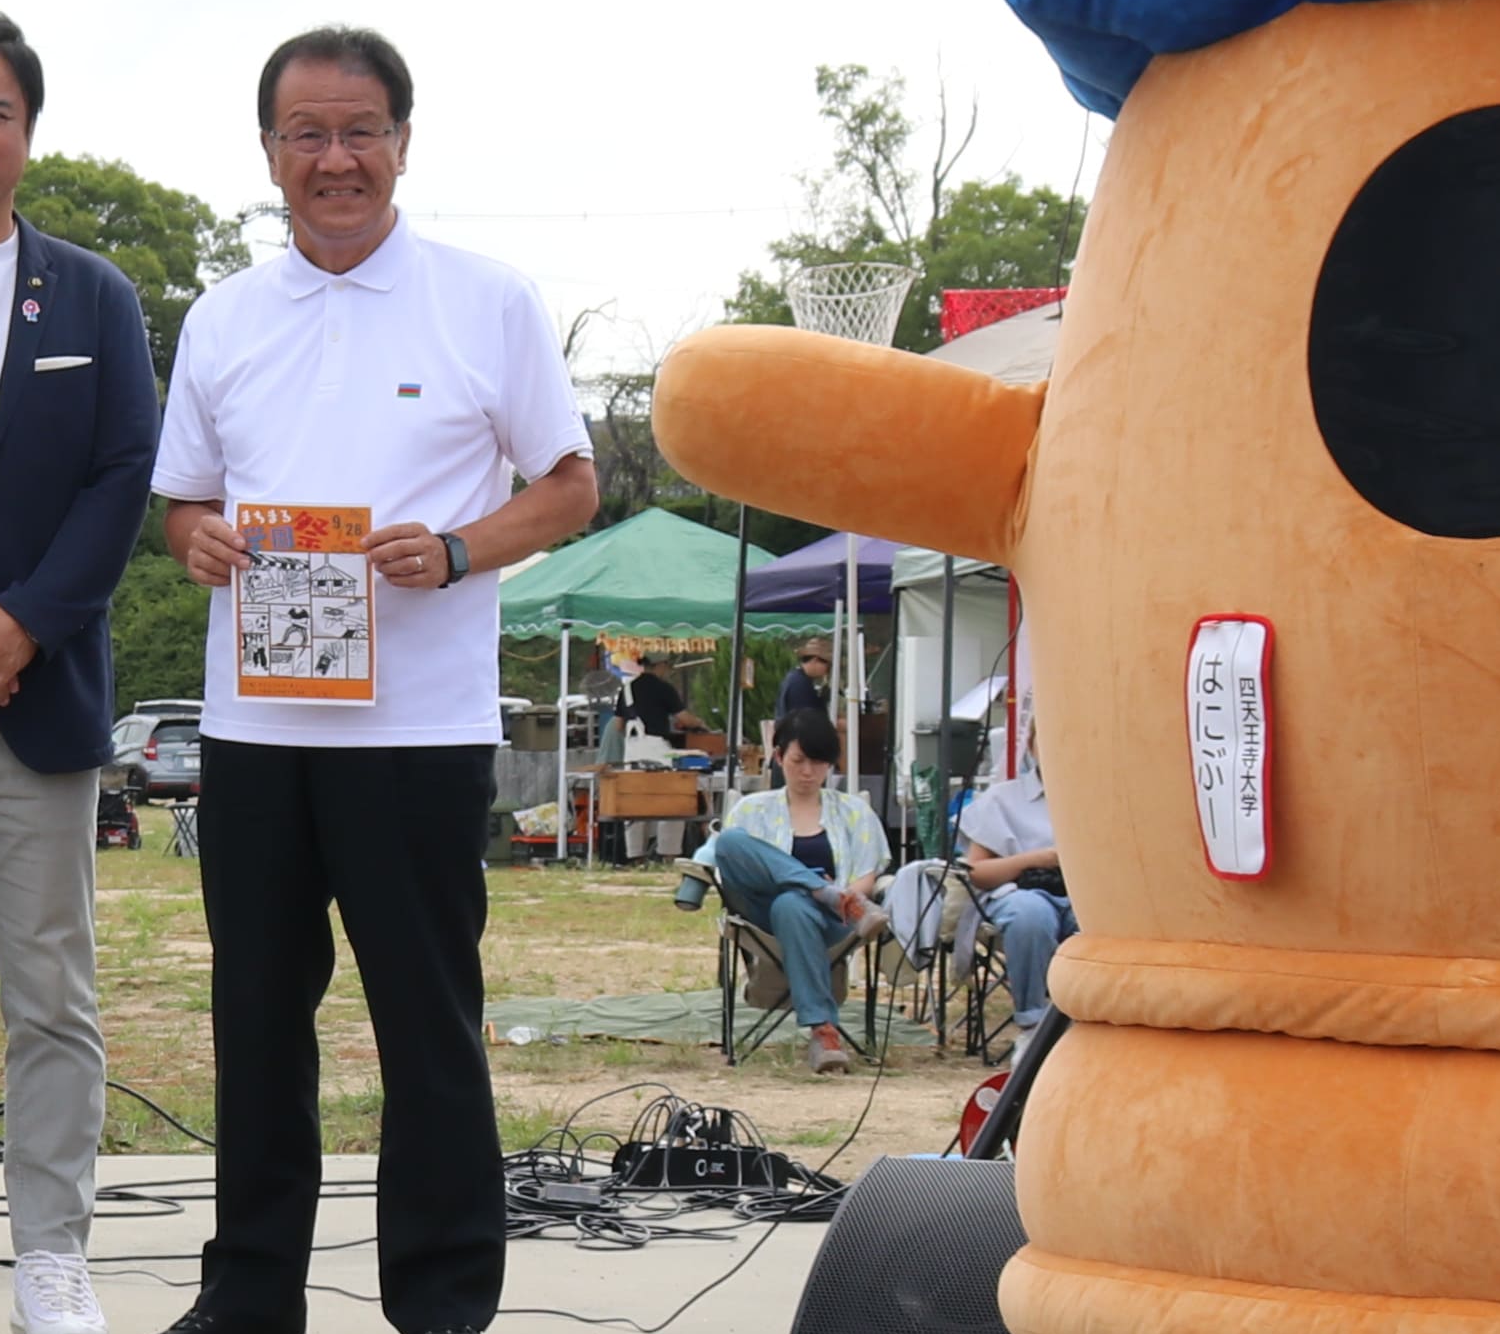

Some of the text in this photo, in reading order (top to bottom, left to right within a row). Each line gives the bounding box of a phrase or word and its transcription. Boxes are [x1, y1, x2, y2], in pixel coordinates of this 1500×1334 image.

[1196, 653, 1226, 839] はにぶー
[1239, 677, 1260, 817] 四天王寺大学
